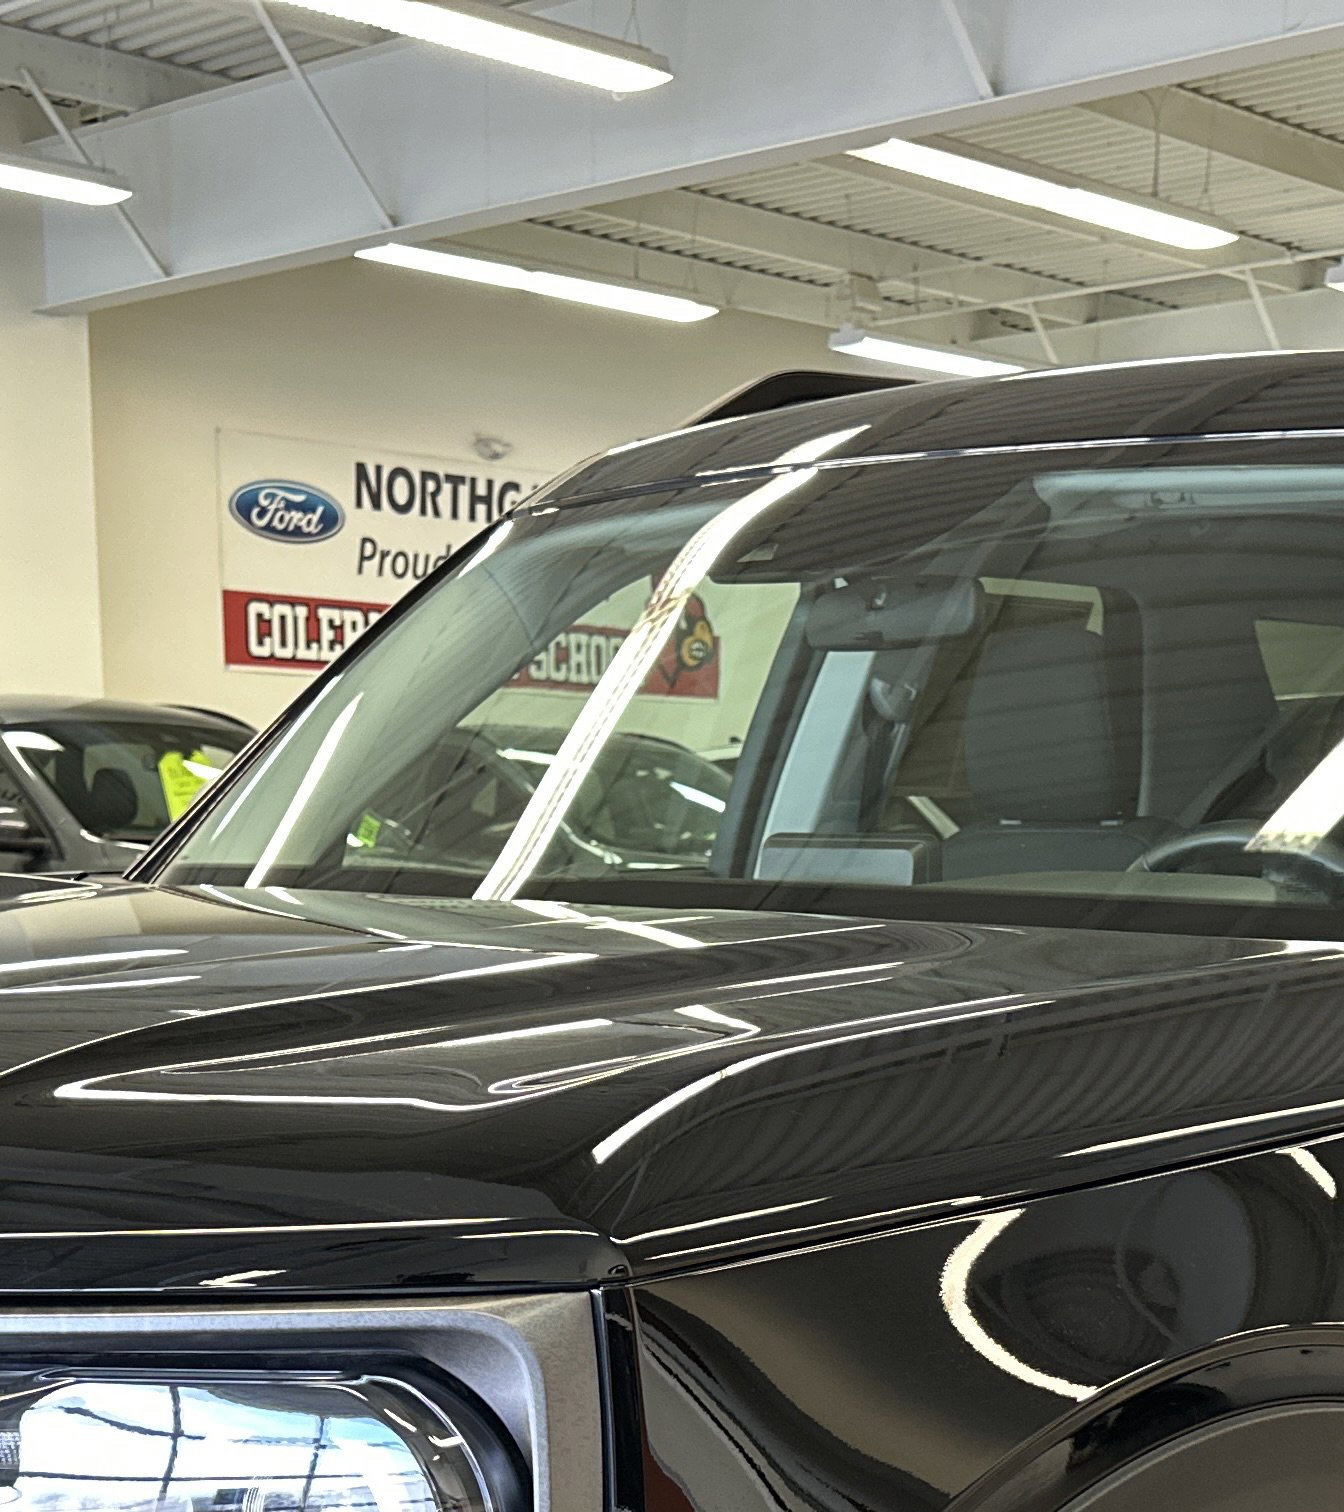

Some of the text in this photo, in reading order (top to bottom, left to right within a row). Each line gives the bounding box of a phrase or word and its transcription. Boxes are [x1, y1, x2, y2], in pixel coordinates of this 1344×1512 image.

[248, 486, 325, 535] Ford
[355, 461, 532, 524] NORTHG
[245, 600, 378, 662] COLER
